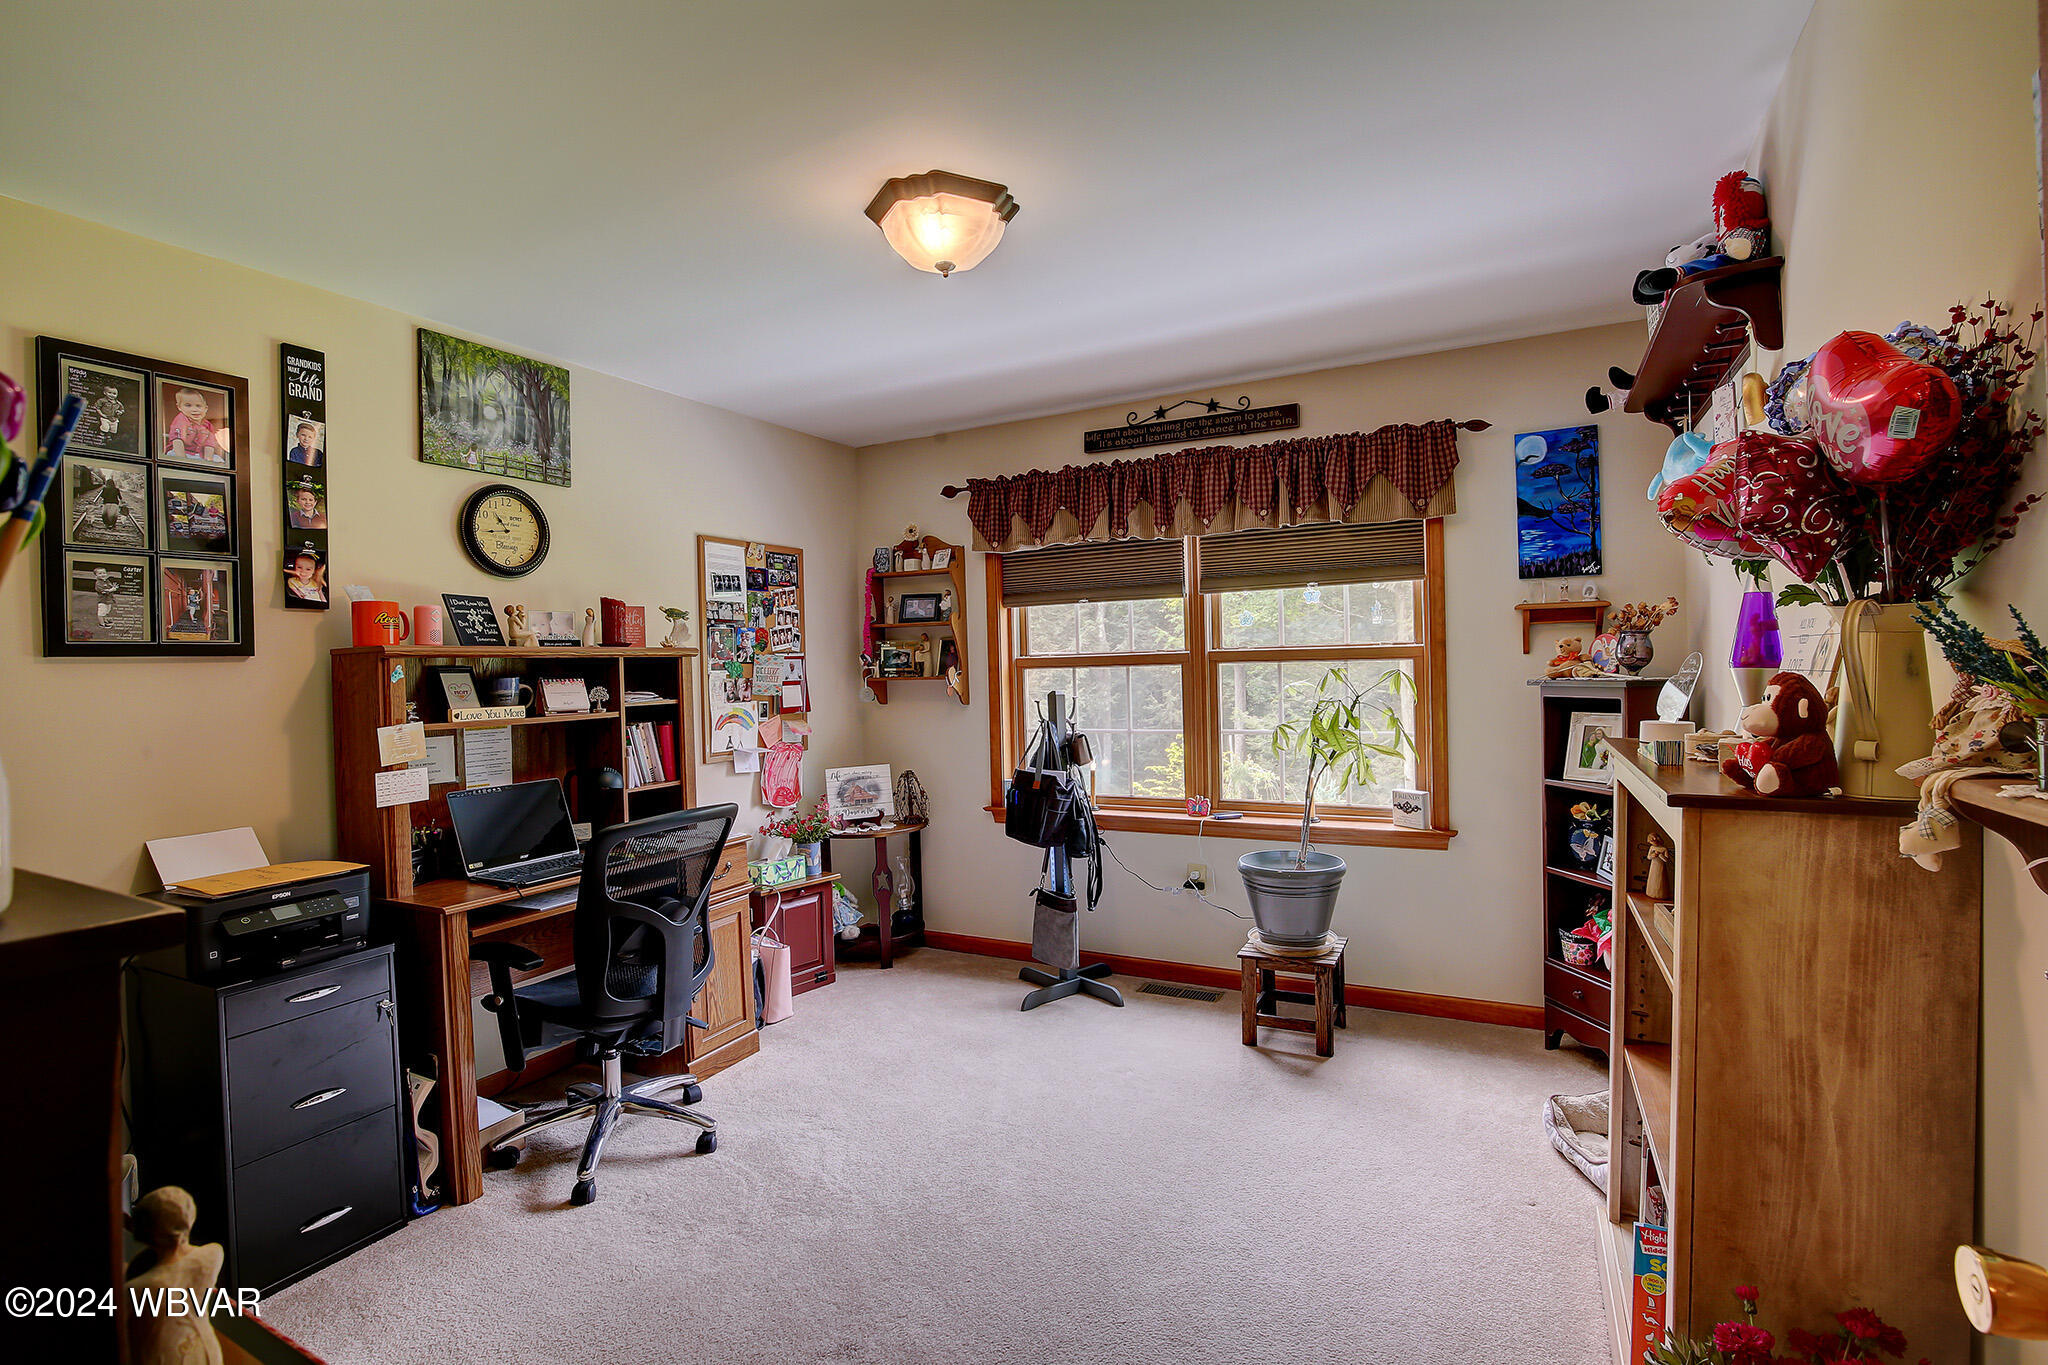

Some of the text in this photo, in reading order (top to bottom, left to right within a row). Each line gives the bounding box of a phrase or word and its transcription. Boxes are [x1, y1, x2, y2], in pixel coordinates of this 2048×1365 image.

[287, 355, 322, 372] GRANDKIDS
[287, 365, 323, 387] MAKE life
[288, 382, 323, 402] GRAND
[1085, 432, 1101, 441] Life
[1103, 430, 1121, 439] isn't
[1122, 427, 1148, 437] about
[1149, 421, 1181, 433] waiting
[1183, 420, 1196, 429] for
[1199, 418, 1213, 426] the
[1215, 415, 1242, 425] storm
[1244, 412, 1255, 421] to
[1099, 439, 1112, 448] It's
[1115, 436, 1143, 445] about
[1145, 430, 1187, 442] learning
[1189, 428, 1200, 436] to
[1202, 425, 1234, 435] dance
[1237, 422, 1247, 431] in
[1250, 419, 1267, 429] the
[487, 500, 498, 509] 11
[500, 497, 512, 507] 12
[477, 510, 489, 519] 10
[528, 514, 534, 524] 2
[533, 530, 538, 540] 3
[528, 544, 535, 554] 4
[491, 551, 498, 560] 7
[519, 554, 525, 563] 5
[504, 556, 511, 566] 6
[459, 708, 525, 721] Love You More
[271, 891, 291, 900] EPSON
